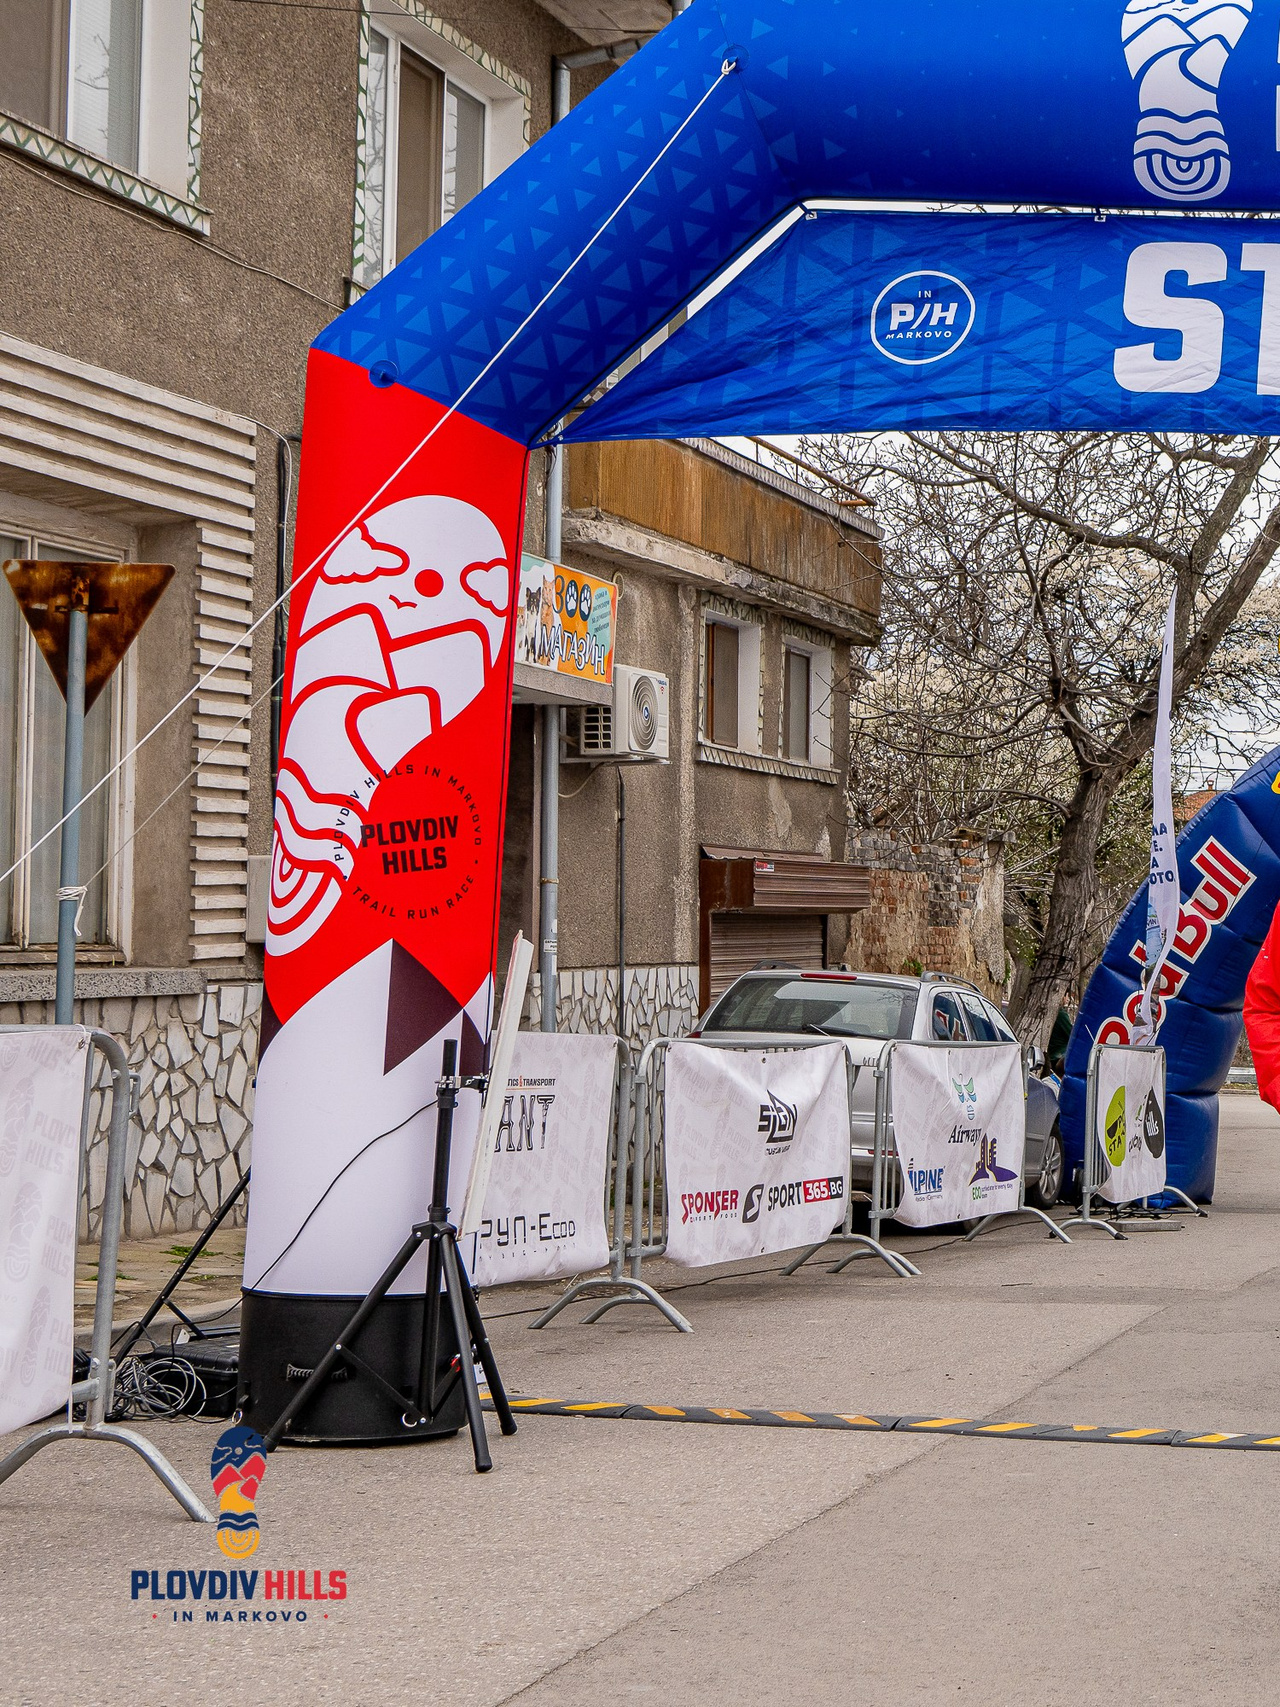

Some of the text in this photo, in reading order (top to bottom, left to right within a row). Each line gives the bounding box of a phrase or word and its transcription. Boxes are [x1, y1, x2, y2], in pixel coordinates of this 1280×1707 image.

[918, 290, 932, 298] IN
[889, 303, 959, 331] P/H
[885, 331, 953, 340] MARKOVO
[540, 623, 605, 676] МАГАЗИН
[334, 764, 482, 861] PLOVDIV HILLS IN MARKOVO
[360, 815, 459, 848] PLOVDIV
[381, 846, 448, 875] HILLS
[352, 874, 474, 919] TRAIL RUN RACE
[1172, 838, 1254, 963] Bull
[523, 1079, 556, 1087] TRANSPORT
[681, 1190, 739, 1225] SPONSER
